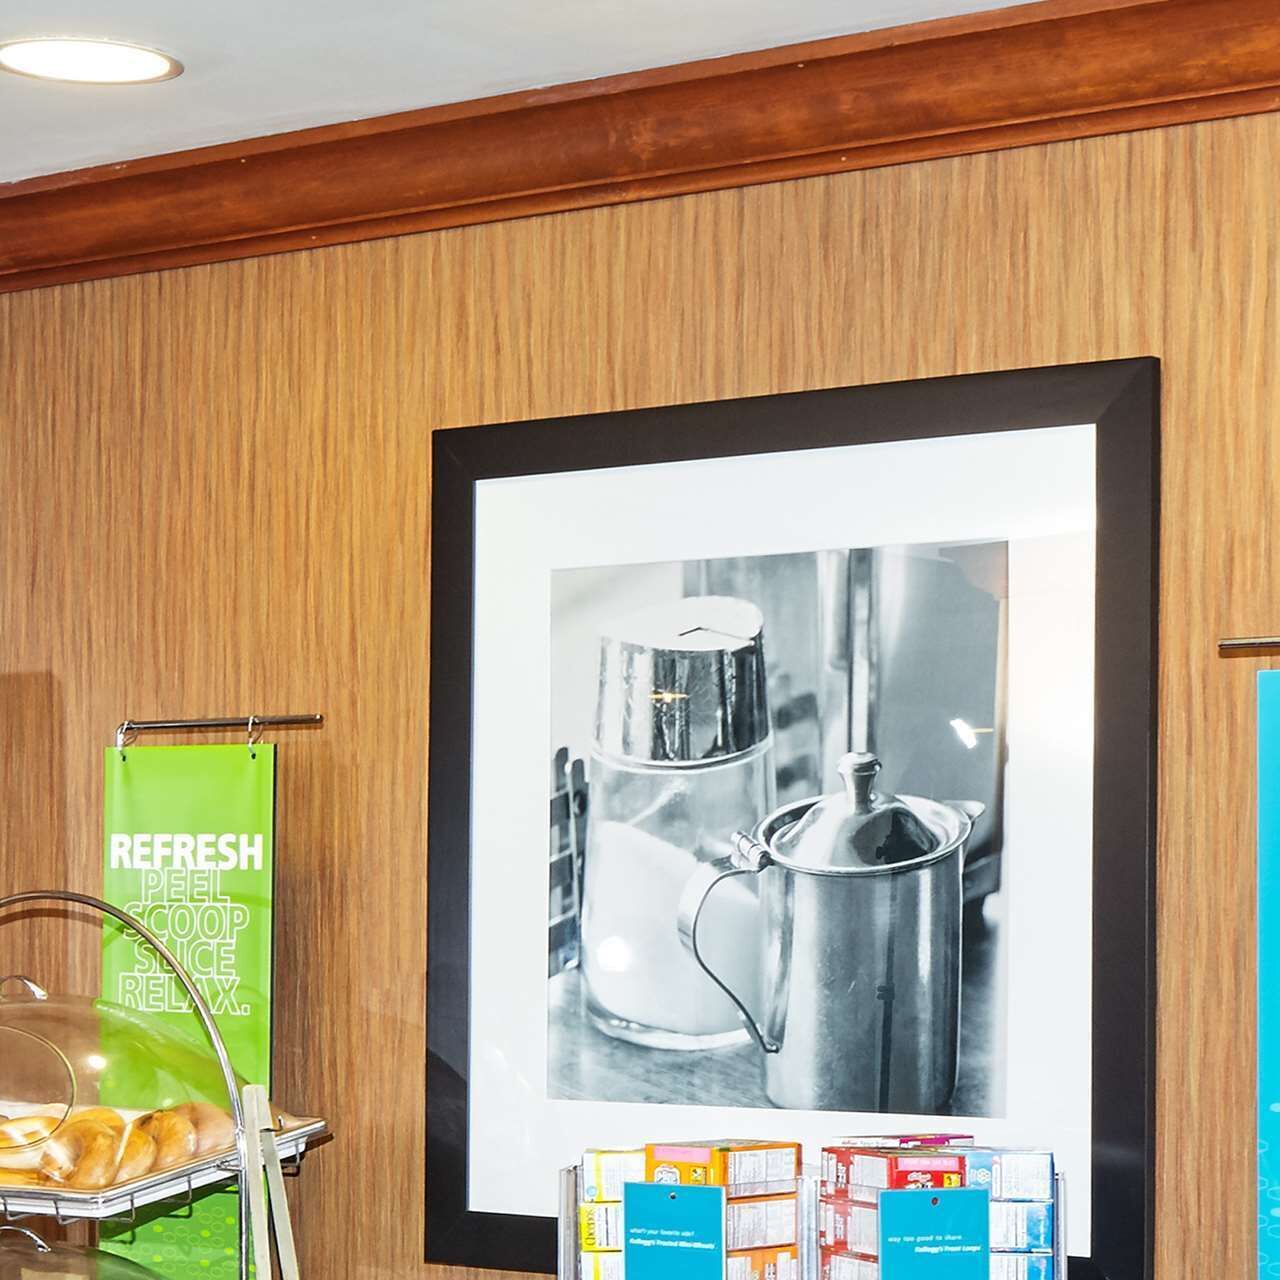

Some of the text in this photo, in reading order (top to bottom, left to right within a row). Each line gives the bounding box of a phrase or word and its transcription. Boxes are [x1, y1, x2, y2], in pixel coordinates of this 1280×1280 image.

[109, 832, 263, 871] REFRESH
[141, 868, 230, 905] PEEL
[122, 901, 250, 942] SCOOP
